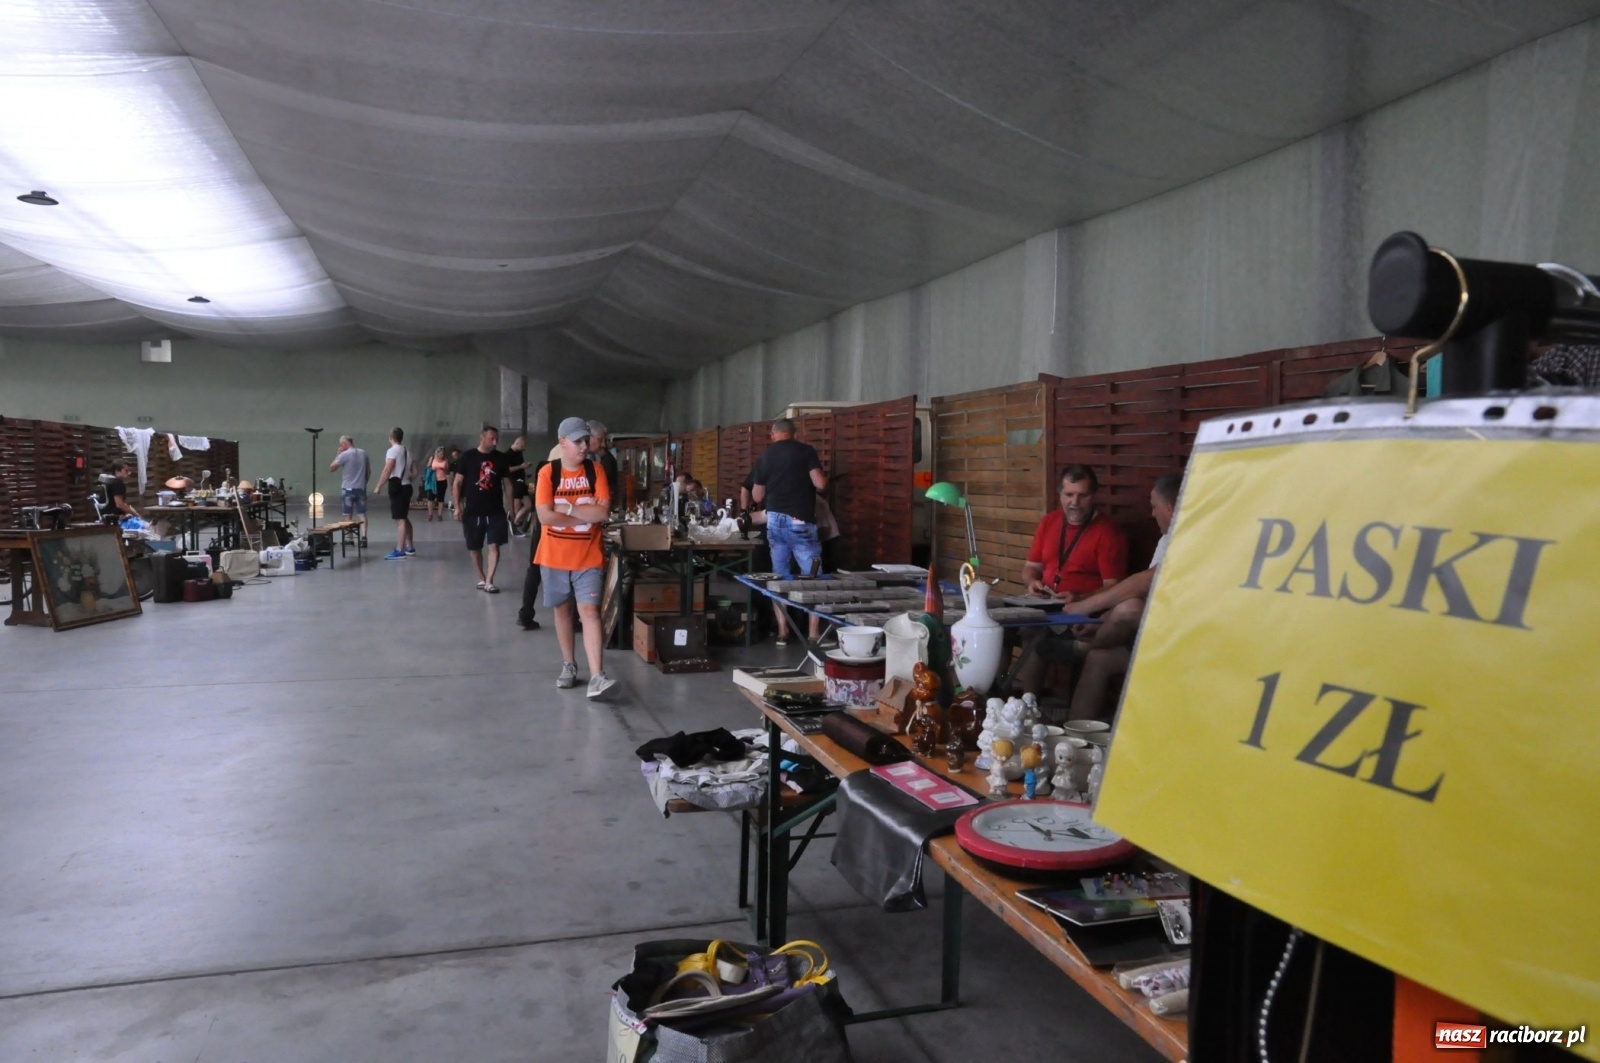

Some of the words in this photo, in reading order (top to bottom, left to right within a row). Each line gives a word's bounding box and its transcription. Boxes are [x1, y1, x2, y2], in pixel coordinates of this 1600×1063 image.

[1239, 518, 1557, 631] PASKI
[1239, 671, 1281, 751] 1
[1294, 682, 1446, 803] ZŁ
